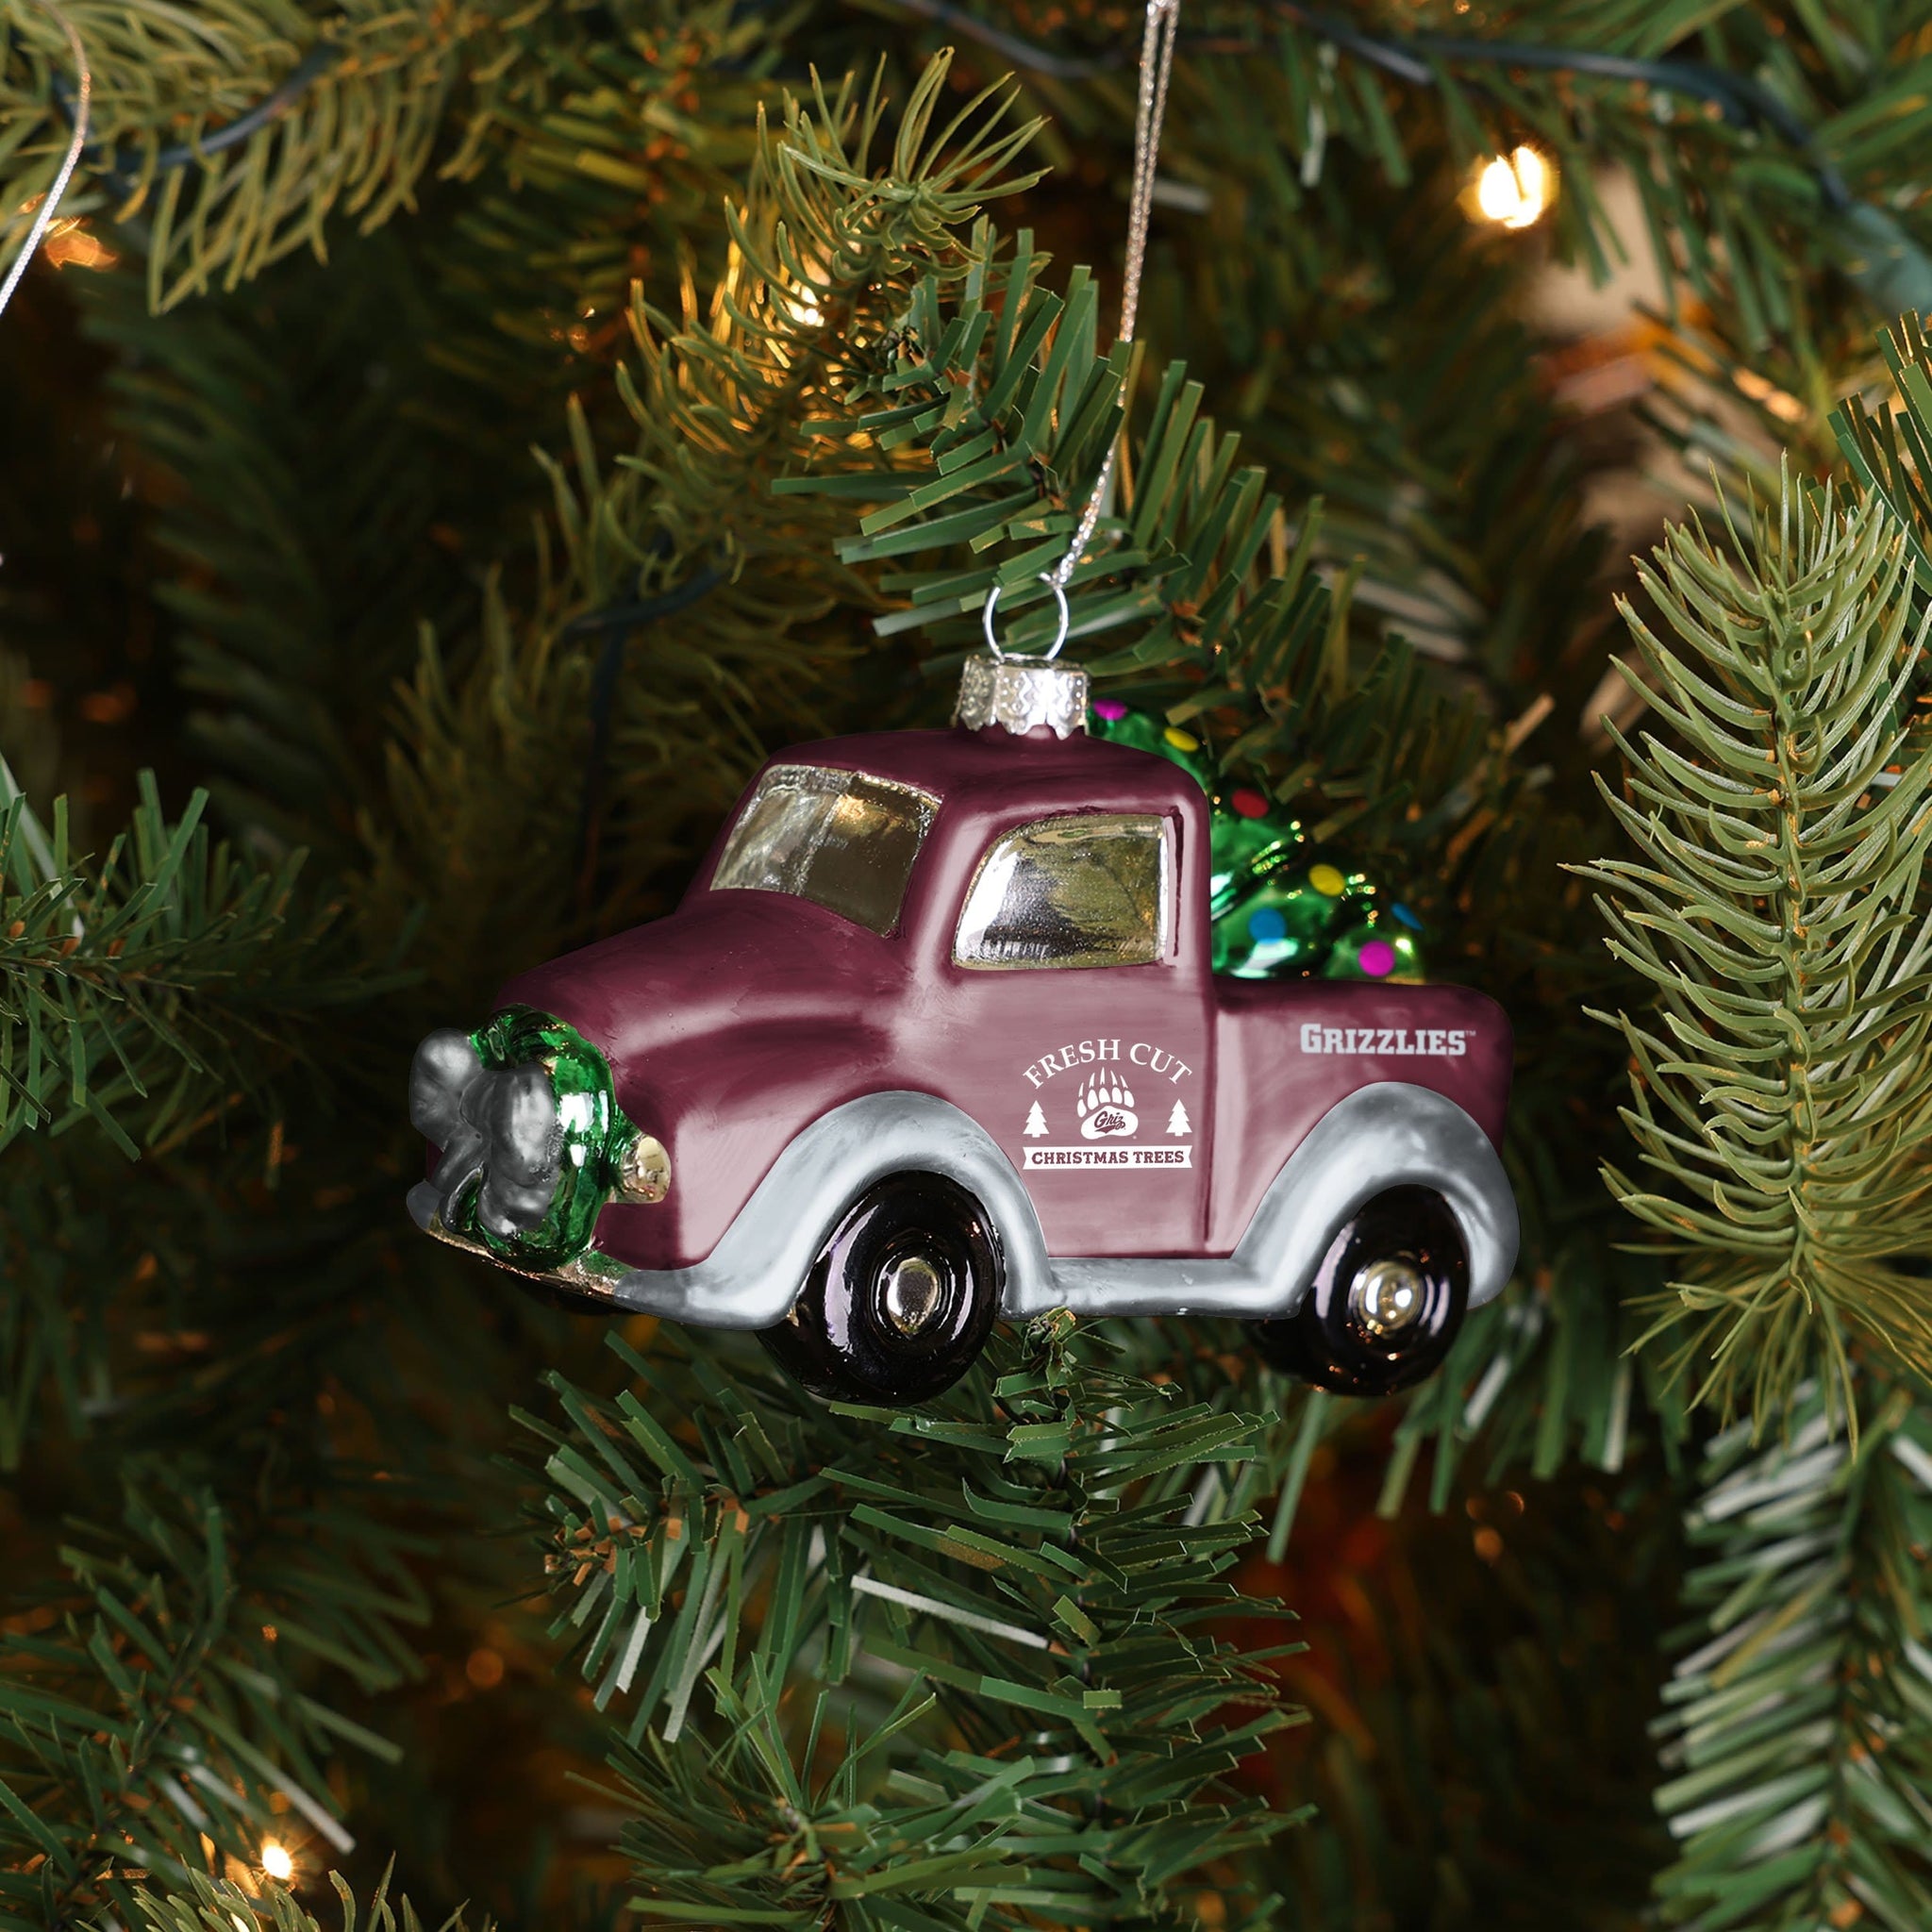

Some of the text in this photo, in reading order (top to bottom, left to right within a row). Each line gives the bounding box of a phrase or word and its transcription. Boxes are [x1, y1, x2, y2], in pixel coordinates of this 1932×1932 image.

[1023, 1039, 1192, 1090] FRESH CUT
[1094, 1110, 1126, 1131] Griz
[1031, 1150, 1185, 1165] CHRISTMAS TREES
